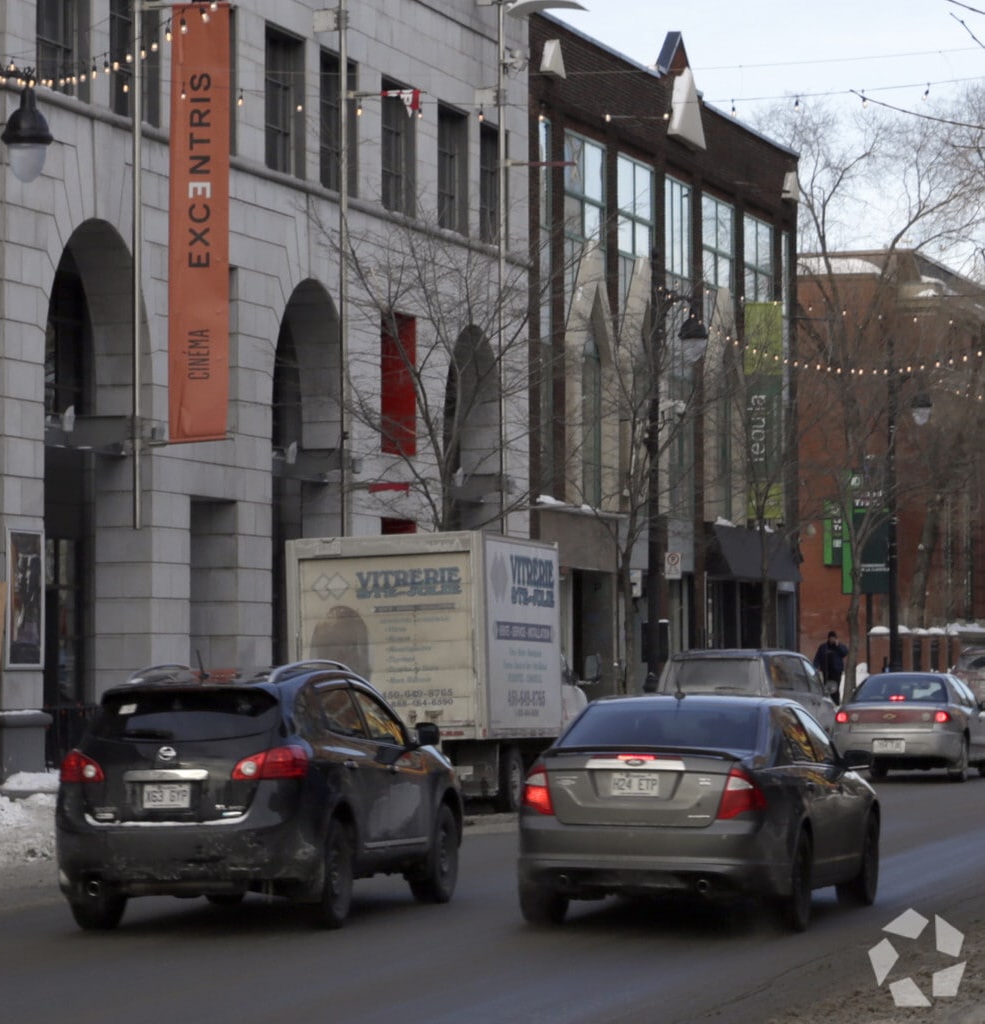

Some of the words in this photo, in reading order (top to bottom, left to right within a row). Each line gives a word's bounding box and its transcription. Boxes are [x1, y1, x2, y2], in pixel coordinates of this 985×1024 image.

[187, 328, 210, 381] CINÉMA
[356, 566, 462, 588] VITRERIE
[510, 555, 554, 588] VITRERIE
[638, 777, 658, 791] ETP
